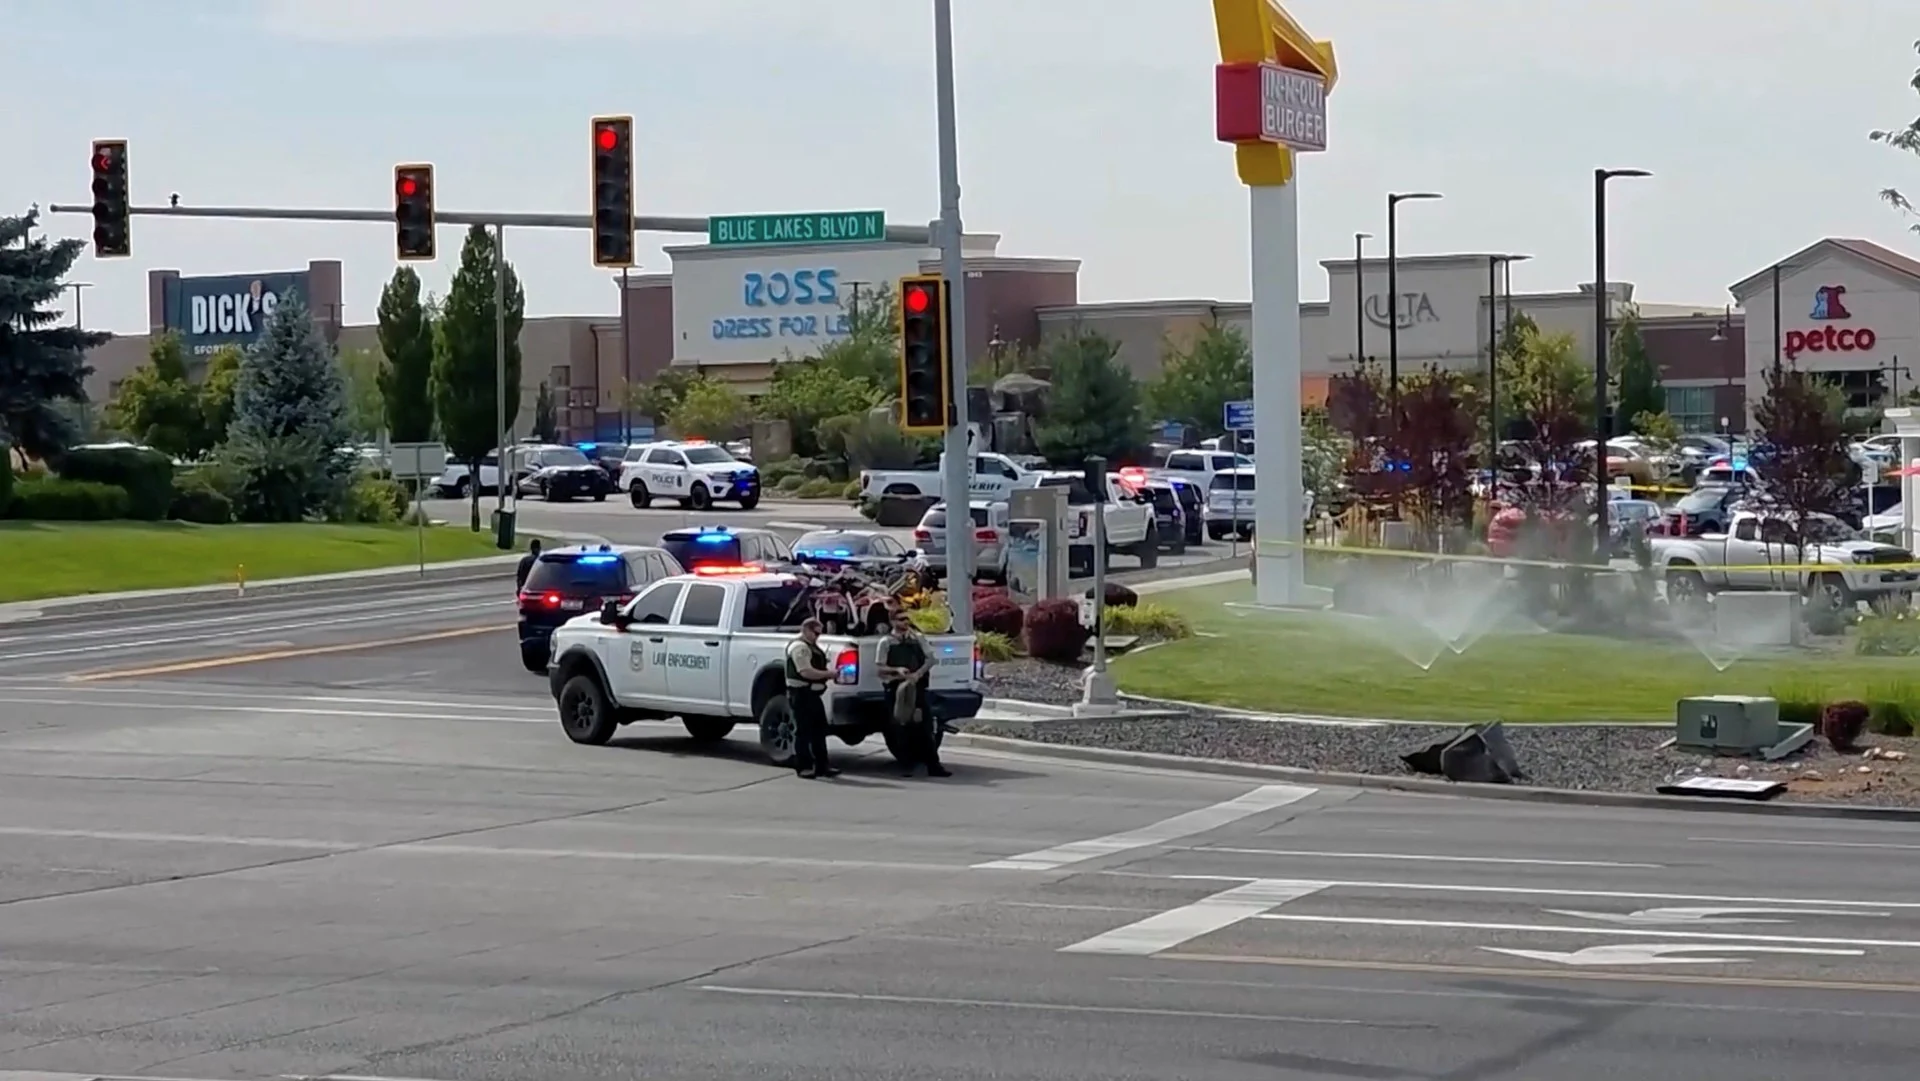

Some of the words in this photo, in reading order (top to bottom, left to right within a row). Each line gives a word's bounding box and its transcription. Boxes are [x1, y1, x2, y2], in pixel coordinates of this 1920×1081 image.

[1265, 104, 1323, 144] BURGER
[718, 220, 757, 241] BLUE
[764, 217, 813, 240] LAKES
[820, 215, 859, 239] BLVD
[865, 215, 876, 236] N
[744, 268, 840, 307] ROSS
[712, 317, 773, 339] DRESS
[779, 315, 818, 337] FOR
[1785, 325, 1876, 360] petco
[652, 651, 667, 666] LAW
[668, 652, 711, 670] ENFORCEMENT
